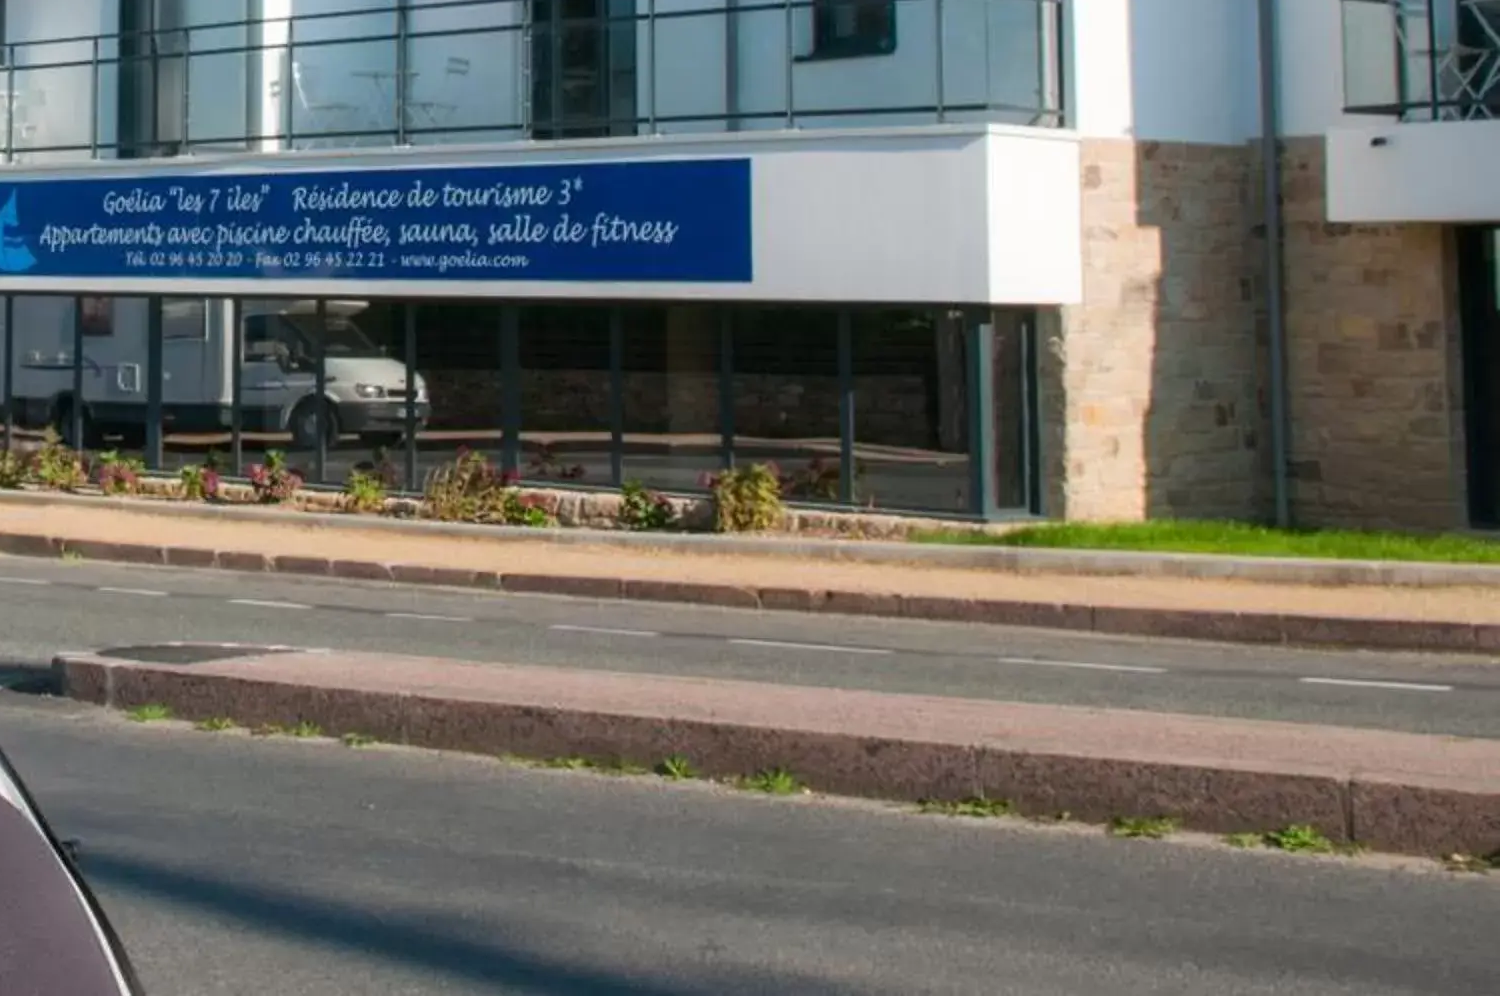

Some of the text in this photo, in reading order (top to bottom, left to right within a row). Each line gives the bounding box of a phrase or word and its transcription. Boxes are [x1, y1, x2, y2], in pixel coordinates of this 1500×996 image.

[209, 188, 221, 213] 7
[292, 181, 405, 212] Résidence
[406, 179, 439, 207] de
[442, 181, 553, 208] tourisme
[39, 211, 679, 253] Appartements avec piscine chauffée, sauna, salle de fitness
[283, 251, 301, 267] 02
[304, 251, 321, 267] 96
[346, 251, 364, 267] 22
[367, 251, 385, 267] 21
[400, 250, 530, 273] www.goelia.com
